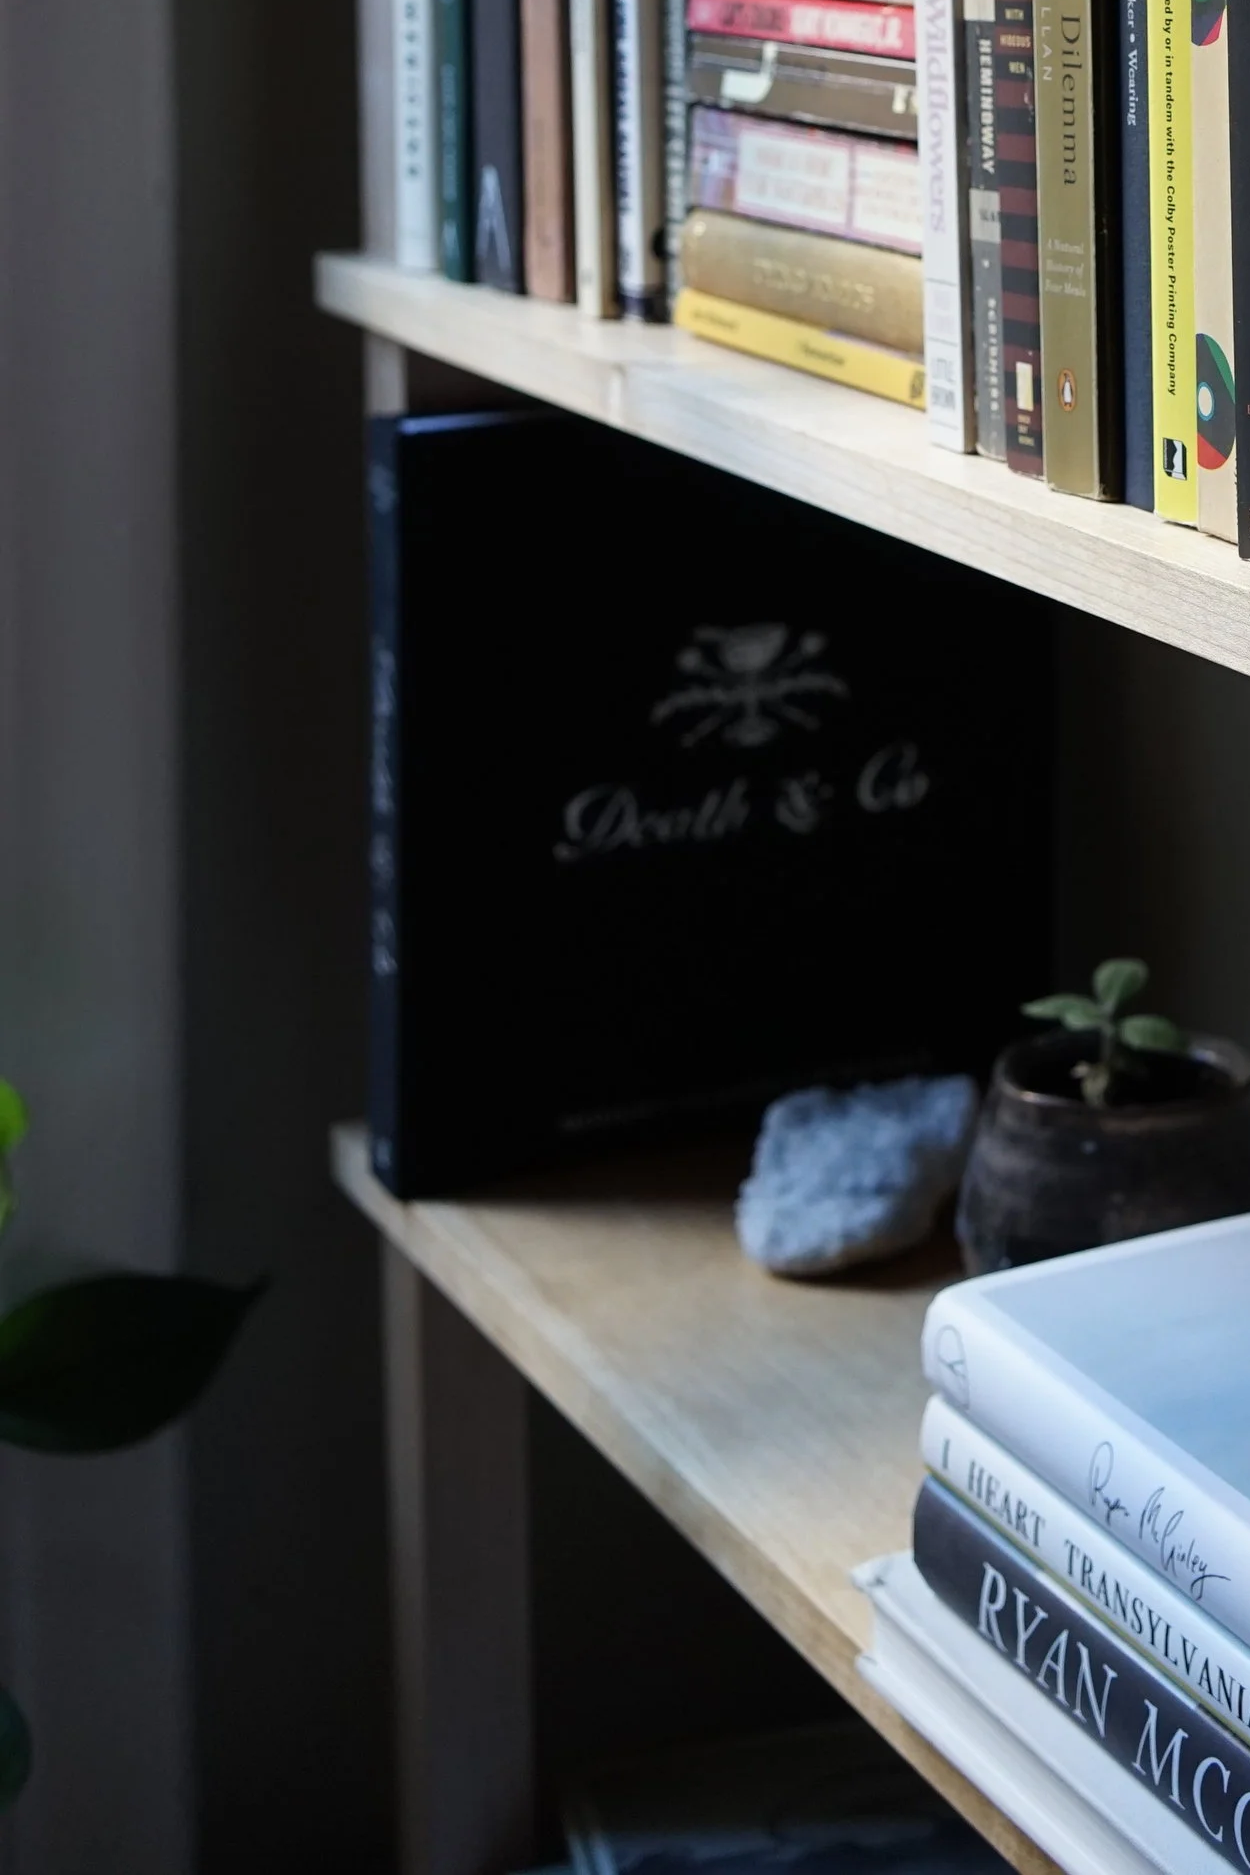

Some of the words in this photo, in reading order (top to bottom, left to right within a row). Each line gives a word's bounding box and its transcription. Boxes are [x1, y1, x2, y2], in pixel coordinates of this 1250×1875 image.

[1161, 18, 1174, 35] by
[1163, 37, 1172, 53] or
[1125, 49, 1139, 126] Wearing
[1164, 55, 1174, 68] in
[978, 38, 995, 175] HEMINGWAY
[1059, 14, 1083, 187] Dilemma
[1164, 71, 1175, 124] tandem
[1165, 126, 1177, 157] with
[1166, 160, 1177, 182] the
[1164, 185, 1178, 223] Colby
[1166, 226, 1178, 271] Poster
[1165, 274, 1179, 330] Printing
[1166, 332, 1179, 396] Company
[966, 1458, 1046, 1548] HEART
[977, 1560, 1119, 1739] RYAN
